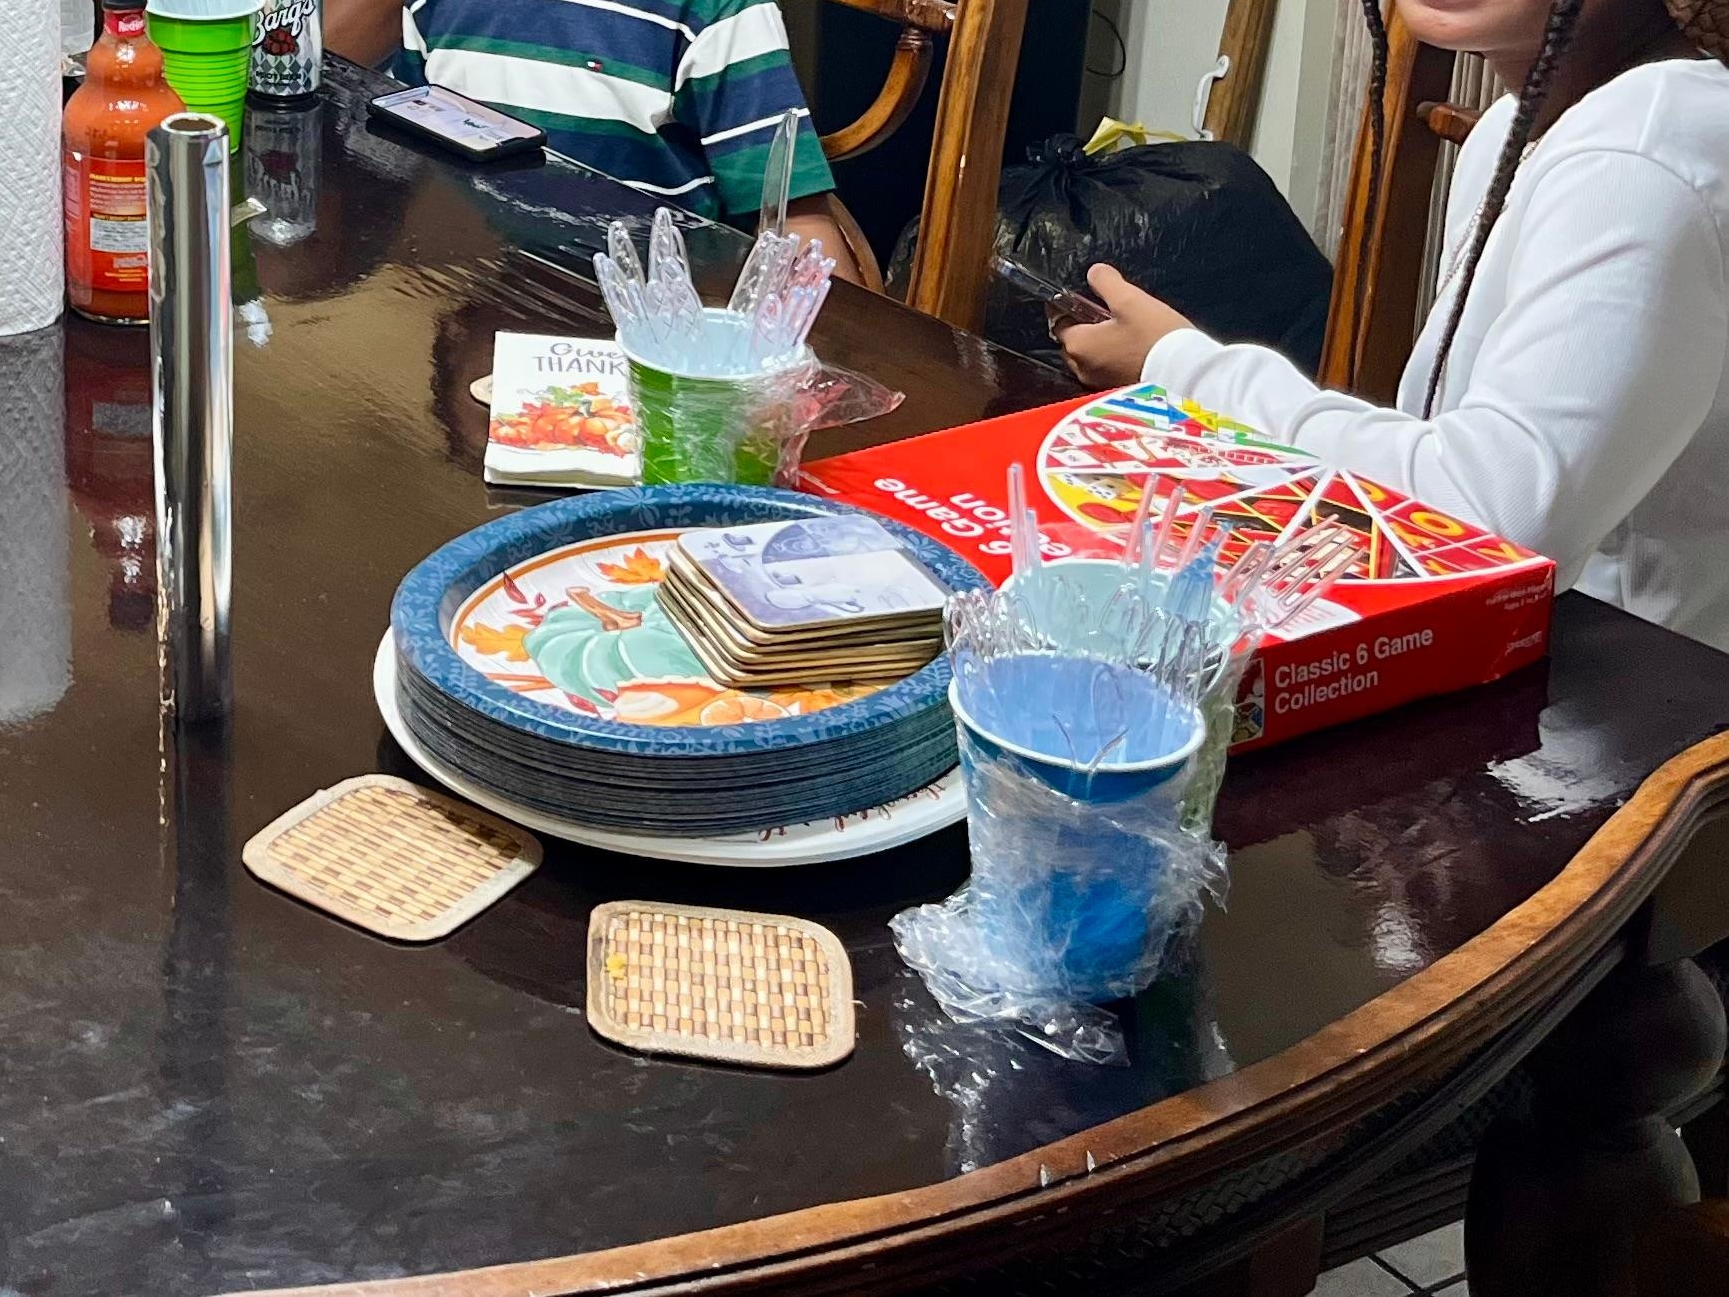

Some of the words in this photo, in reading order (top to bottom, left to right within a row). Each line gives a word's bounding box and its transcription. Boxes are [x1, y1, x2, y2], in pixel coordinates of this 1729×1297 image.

[533, 356, 627, 377] THANK
[550, 342, 626, 359] Give
[873, 478, 985, 538] Game
[1274, 649, 1351, 688] Classic
[1356, 643, 1368, 665] 6
[1374, 628, 1434, 660] Game
[1274, 669, 1379, 715] Collection
